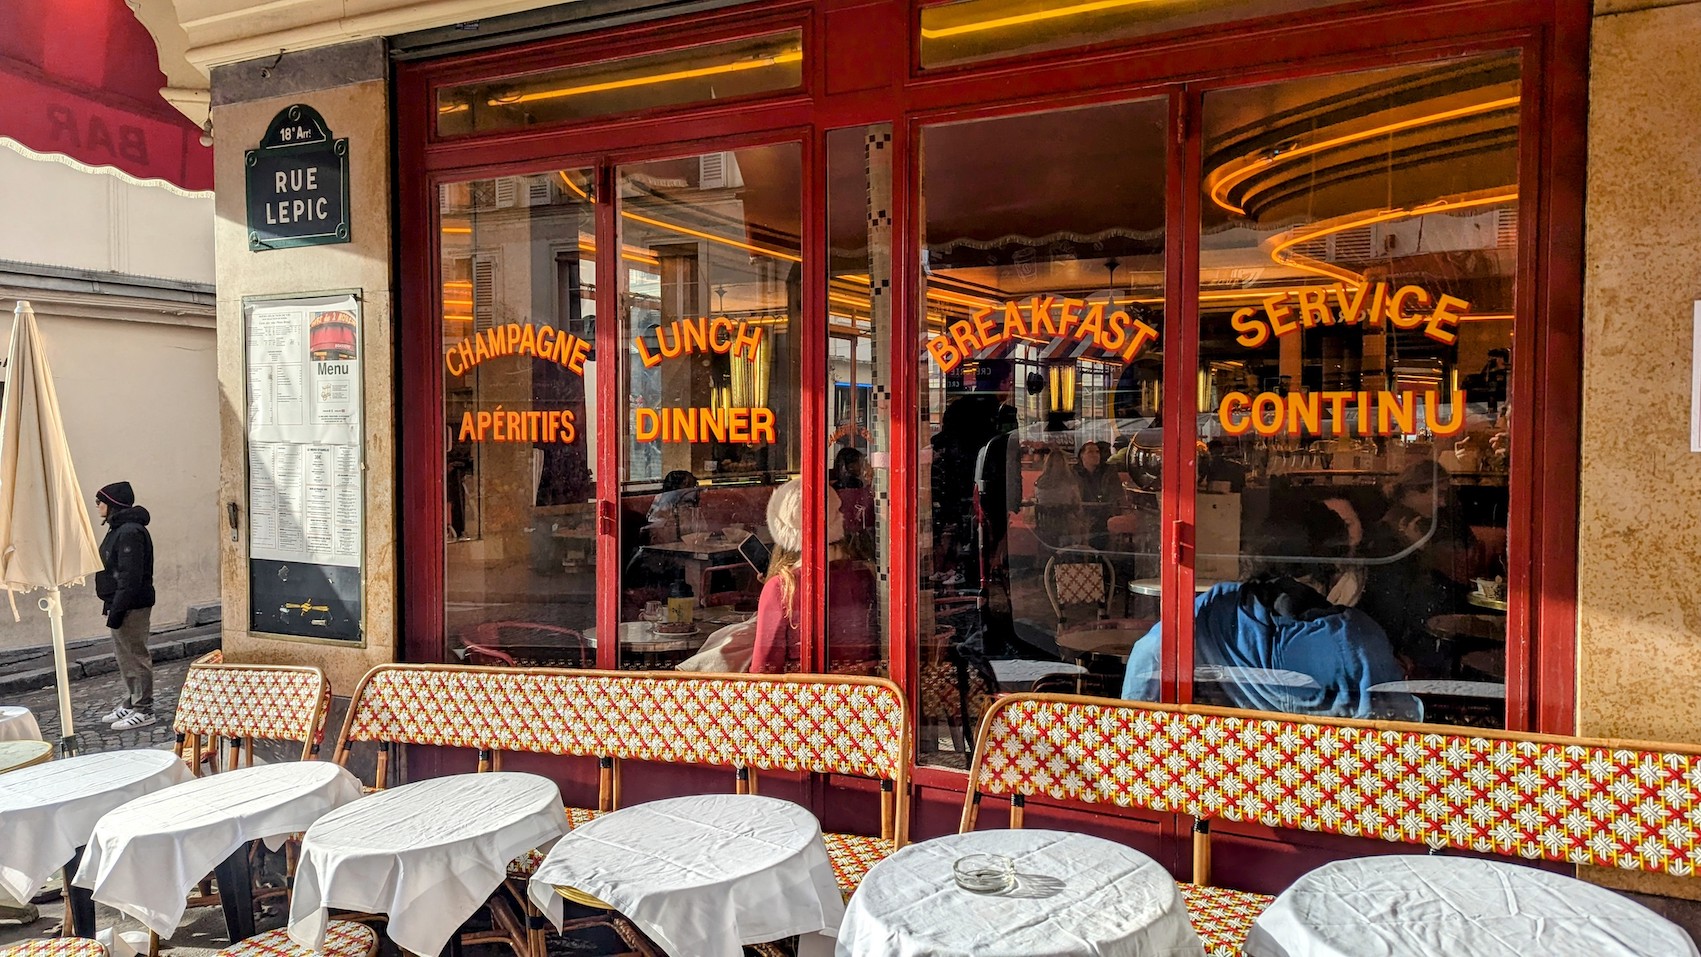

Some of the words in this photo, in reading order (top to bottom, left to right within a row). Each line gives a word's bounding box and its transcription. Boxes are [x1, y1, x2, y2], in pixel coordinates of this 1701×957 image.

[275, 167, 318, 194] RUE
[265, 197, 328, 225] LEPIC
[926, 296, 1160, 374] BREAKFAST
[1230, 281, 1471, 348] SERVICE
[445, 323, 593, 377] CHAMPAGNE
[635, 317, 764, 368] LUNCH
[317, 362, 349, 375] Menu
[458, 404, 577, 444] APÉRITIFS
[636, 407, 776, 444] DINNER
[1218, 390, 1467, 437] CONTINU
